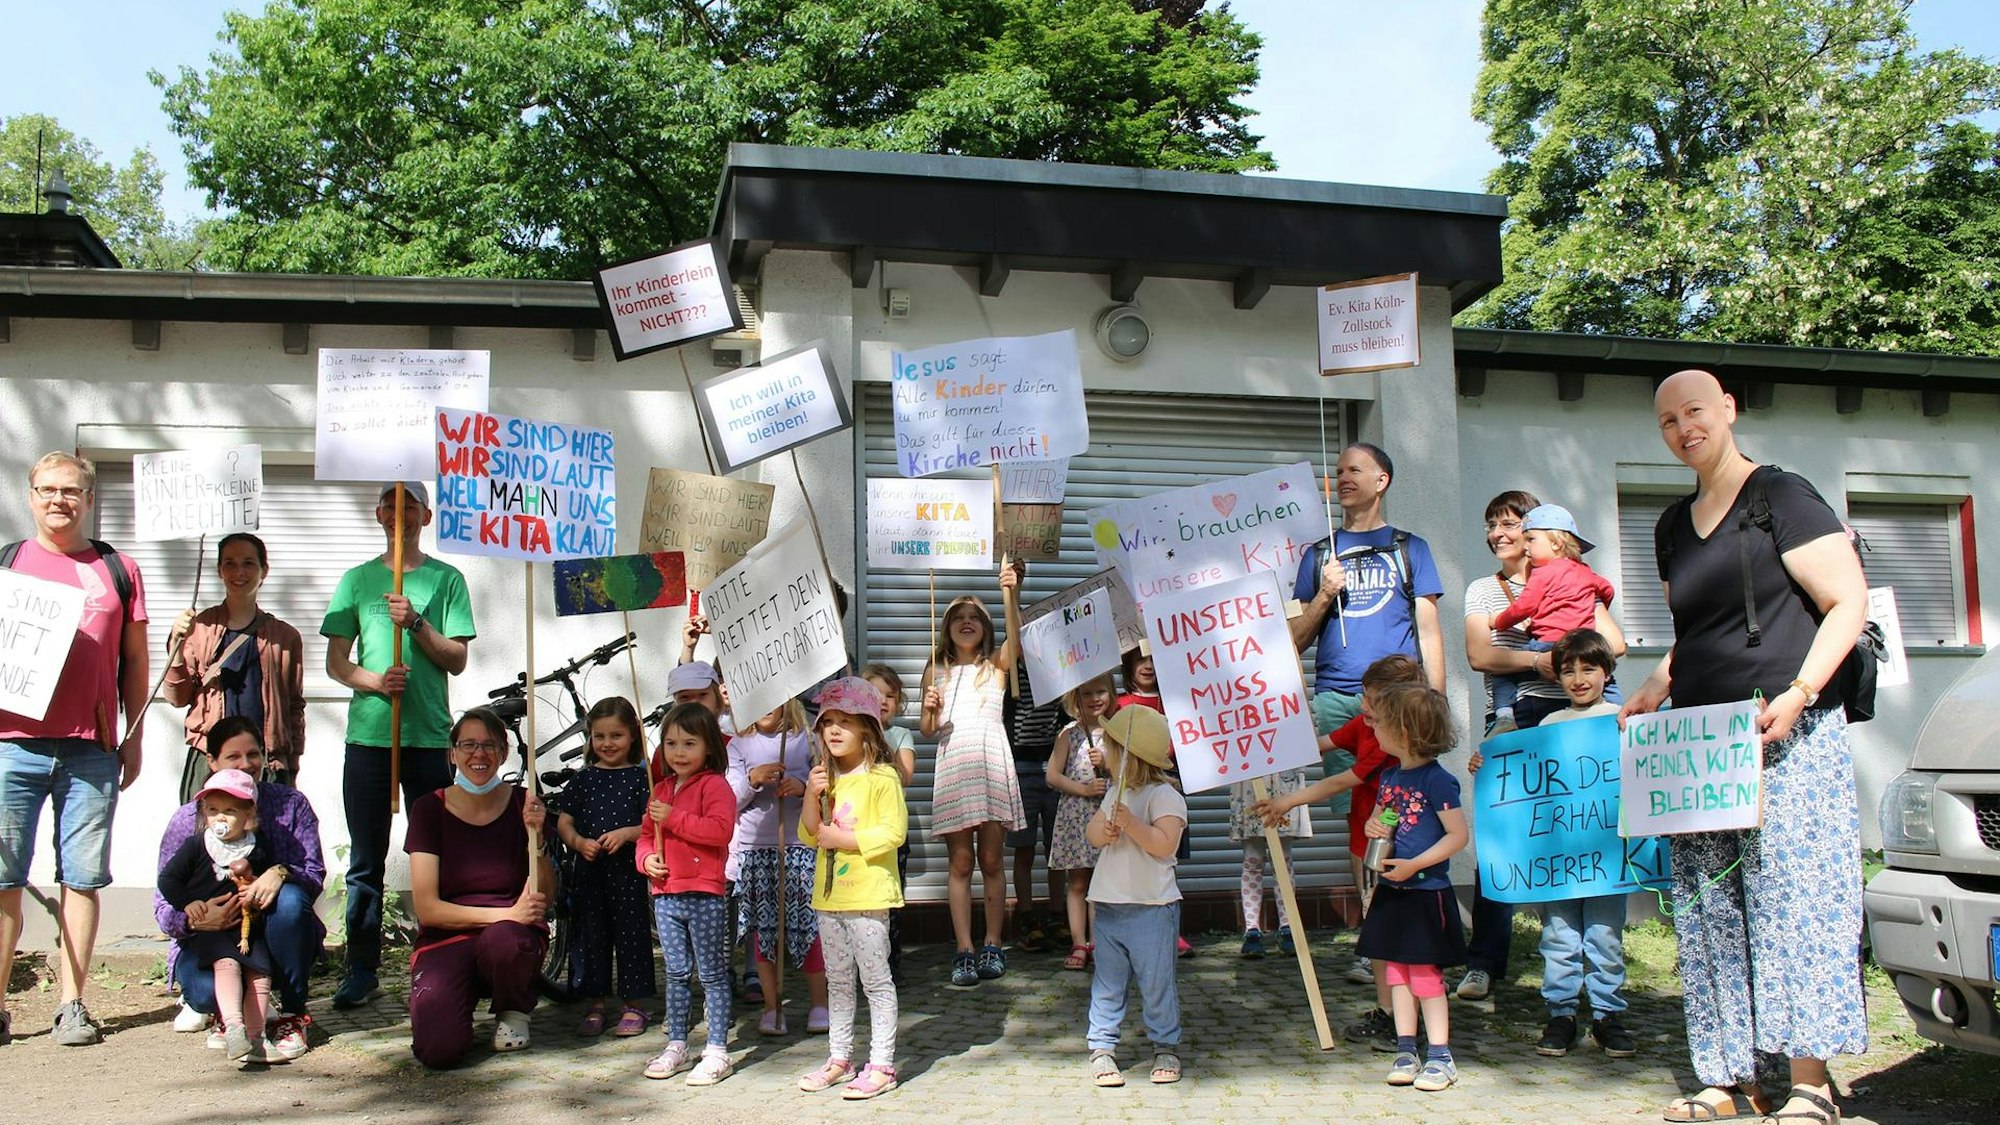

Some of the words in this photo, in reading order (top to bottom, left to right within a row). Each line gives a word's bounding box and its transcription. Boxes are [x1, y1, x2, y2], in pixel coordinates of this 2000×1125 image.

[611, 284, 632, 301] Ihr
[636, 264, 714, 294] Kinderlein
[616, 290, 677, 316] kommet
[640, 303, 707, 332] NICHT???
[1329, 303, 1345, 316] Ev.
[1349, 300, 1371, 313] Kita
[1374, 294, 1406, 310] Köln-
[1342, 315, 1393, 334] Zollstock
[326, 355, 343, 366] Die
[400, 354, 435, 365] Kindern
[1331, 341, 1358, 354] muss
[1361, 334, 1405, 350] bleiben!
[326, 371, 346, 381] auch
[893, 354, 957, 381] Jesus
[968, 348, 1006, 373] sagt:
[729, 393, 753, 410] Ich
[756, 380, 784, 400] will
[786, 374, 803, 388] in
[896, 384, 928, 404] Alle
[934, 374, 1007, 401] Kinder
[1013, 378, 1058, 397] dürfen
[728, 403, 780, 431] meiner
[784, 389, 816, 409] Kita
[918, 409, 938, 420] mir
[944, 396, 1004, 418] kommen!
[329, 421, 347, 433] Du
[439, 412, 500, 448] WIR
[507, 419, 568, 452] SIND
[571, 429, 614, 464] HIER
[747, 411, 809, 444] bleiben!
[898, 433, 926, 449] Das
[932, 426, 959, 449] gilt
[965, 423, 984, 443] für
[991, 420, 1037, 437] diese
[141, 459, 193, 476] KLEINE
[438, 441, 490, 478] WIR
[490, 451, 549, 483] SIND
[550, 460, 613, 491] LAUT
[908, 444, 981, 477] Kirche
[990, 436, 1037, 461] nicht
[141, 474, 206, 502] KINDER
[215, 478, 260, 497] KLEINE
[436, 472, 487, 512] WEIL
[490, 478, 558, 518] MAHN
[568, 490, 616, 526] UNS
[652, 476, 686, 497] WIR
[695, 481, 731, 504] SIND
[737, 493, 769, 512] HIER
[168, 497, 254, 531] RECHTE
[649, 500, 681, 521] WIR
[688, 507, 725, 527] SIND
[729, 515, 767, 535] LAUT
[874, 508, 911, 519] unsere
[916, 502, 970, 521] KITA
[1016, 504, 1059, 522] KITA
[1178, 500, 1302, 542] brauchen
[440, 510, 474, 542] DIE
[479, 512, 552, 554] KITA
[556, 521, 616, 556] KLAUT
[645, 523, 683, 548] WEIL
[721, 539, 748, 556] UNS
[874, 524, 904, 538] klaut,
[911, 524, 944, 538] dann
[1012, 523, 1057, 538] OFFEN
[891, 540, 931, 556] UNSERE
[707, 571, 752, 622] BITTE
[1137, 566, 1222, 599] unsere
[7, 588, 62, 621] SIND
[718, 593, 782, 656] RETTET
[788, 568, 822, 612] DEN
[1063, 602, 1092, 626] Kita
[1157, 591, 1275, 647] UNSERE
[728, 605, 839, 700] KINDERGARTEN
[1058, 638, 1090, 670] toll!
[1186, 635, 1264, 676] KITA
[1190, 670, 1268, 711] MUSS
[1175, 692, 1301, 746] BLEIBEN
[1628, 720, 1659, 749] ICH
[1664, 714, 1717, 744] WILL
[1727, 712, 1750, 737] IN
[1491, 750, 1570, 801] FÜR
[1635, 749, 1698, 779] MEINER
[1706, 741, 1755, 774] KITA
[1647, 781, 1758, 817] BLEIBEN!
[1490, 851, 1608, 892] UNSERER
